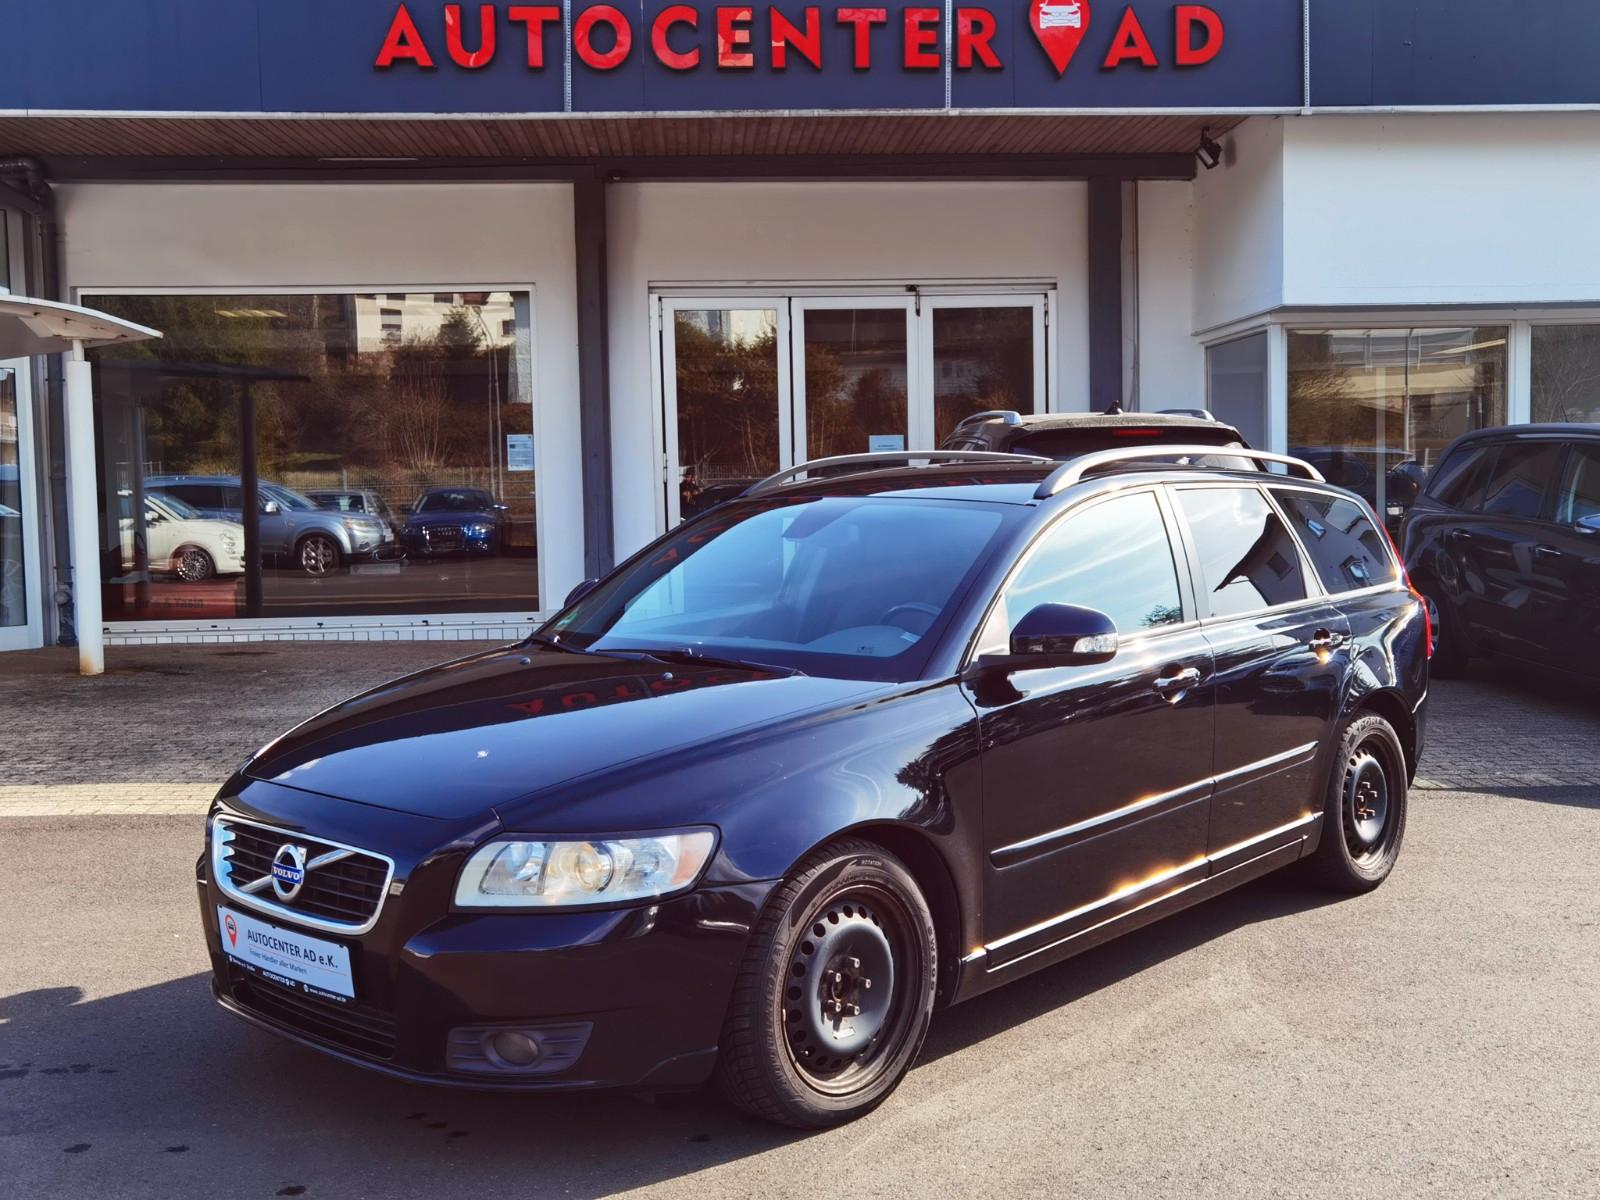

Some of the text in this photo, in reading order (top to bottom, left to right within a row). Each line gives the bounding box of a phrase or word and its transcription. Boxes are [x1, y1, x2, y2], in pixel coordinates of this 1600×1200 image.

[375, 4, 1226, 70] AUTOCENTER AD
[273, 866, 300, 881] VOLVO
[247, 929, 339, 969] AUTOCENTER AD e.K.
